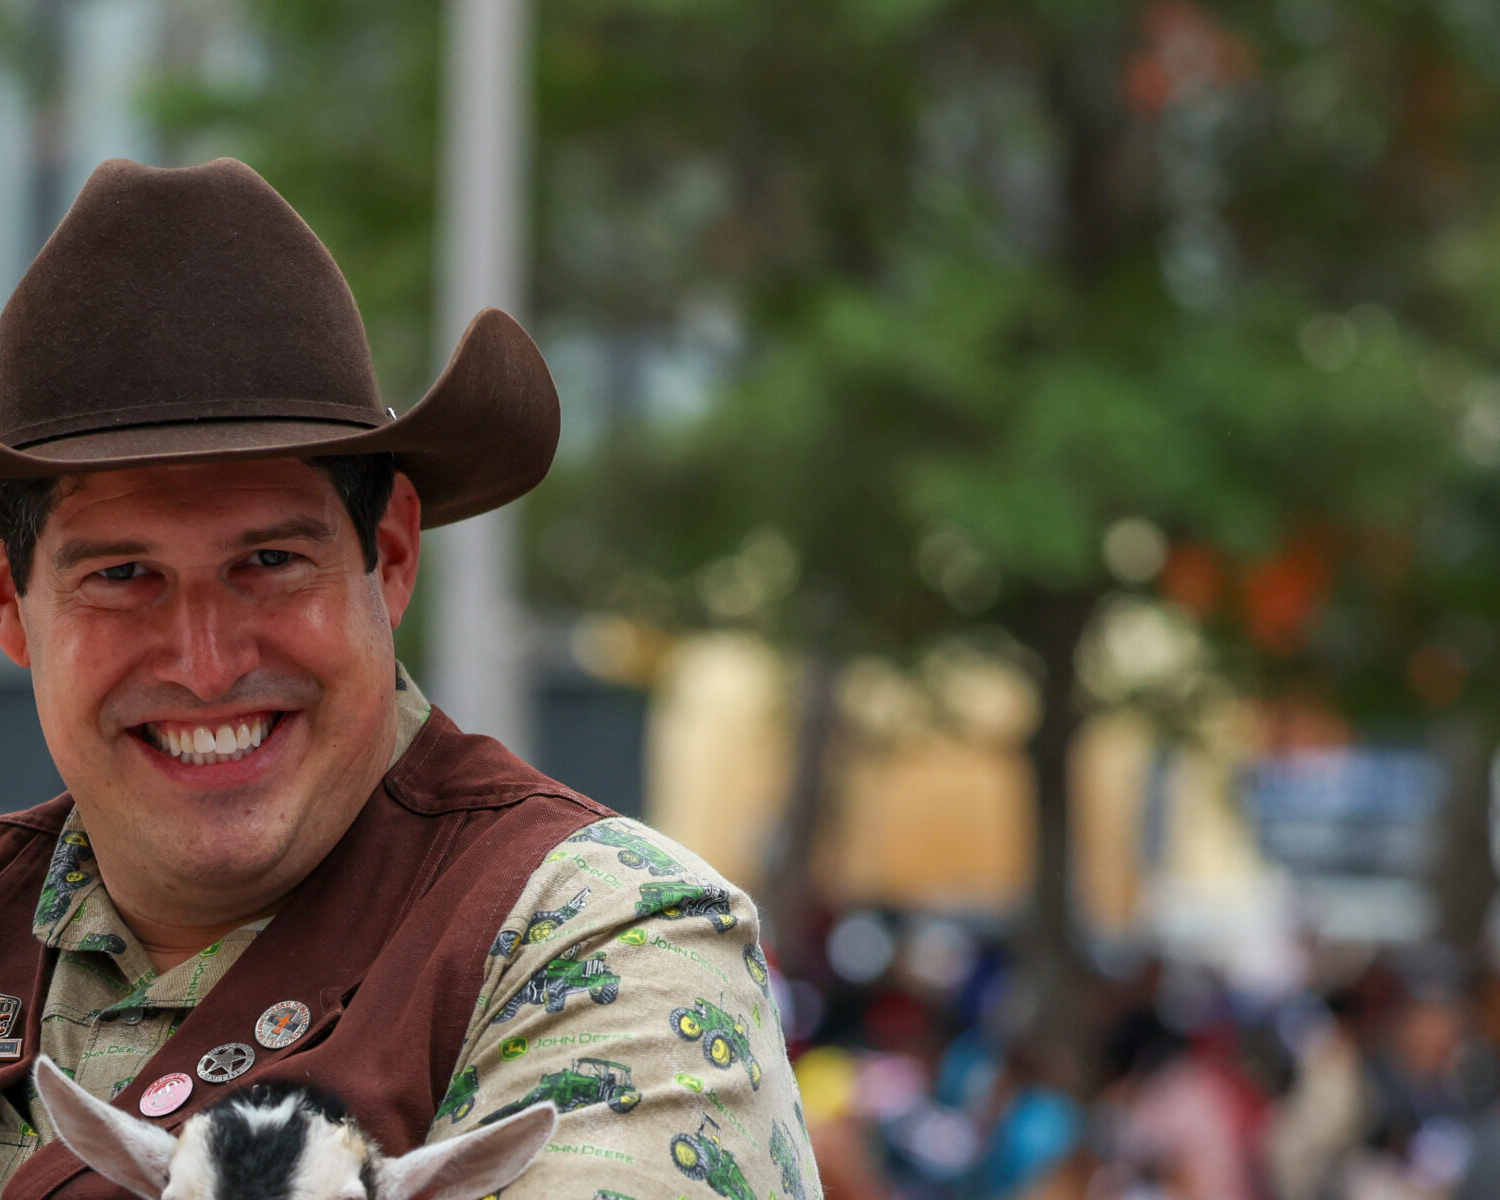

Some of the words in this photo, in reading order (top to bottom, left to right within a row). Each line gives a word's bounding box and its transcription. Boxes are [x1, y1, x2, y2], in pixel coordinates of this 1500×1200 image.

[571, 854, 604, 877] JOHN
[649, 935, 688, 957] JOHN
[187, 960, 208, 996] JOHN
[532, 1034, 576, 1049] JOHN
[80, 1050, 105, 1060] OHN
[544, 1143, 579, 1154] OHN
[581, 1144, 636, 1165] DEERE
